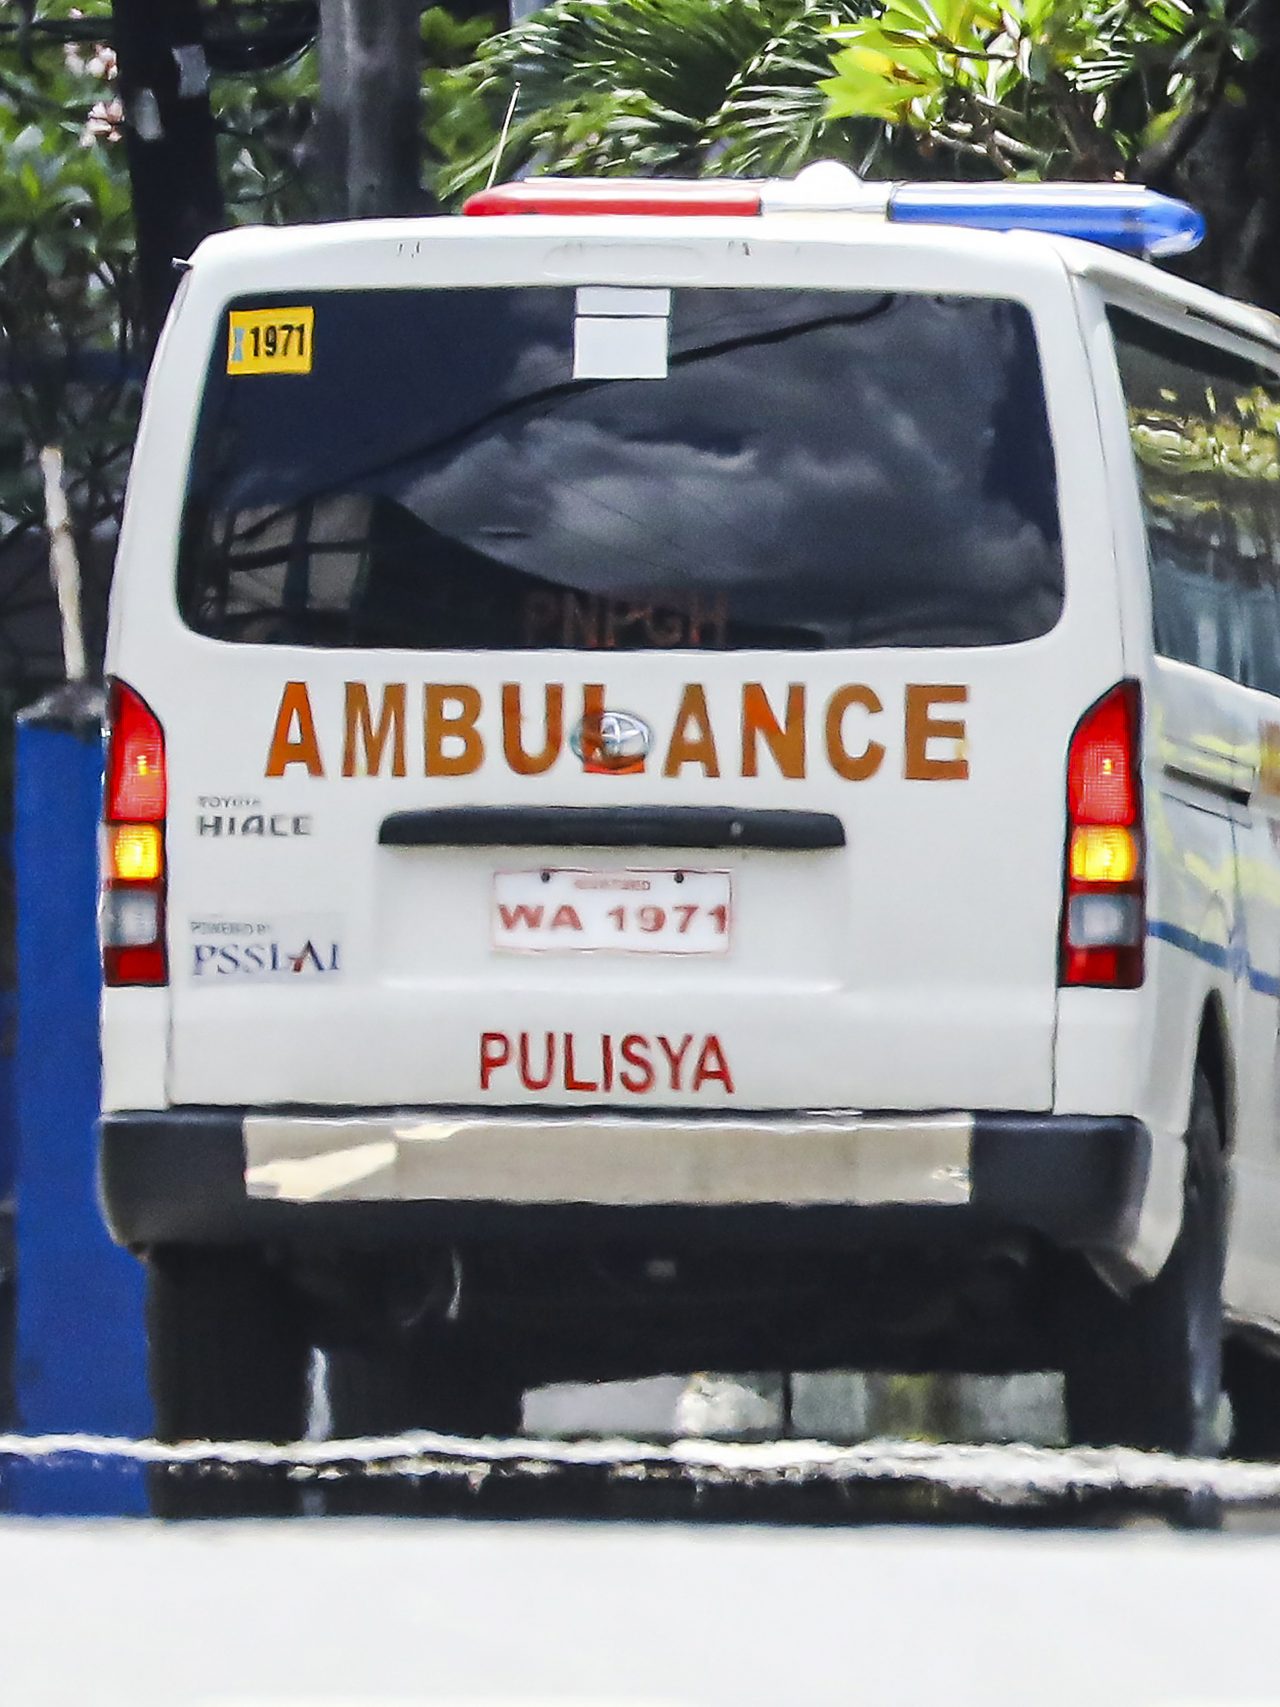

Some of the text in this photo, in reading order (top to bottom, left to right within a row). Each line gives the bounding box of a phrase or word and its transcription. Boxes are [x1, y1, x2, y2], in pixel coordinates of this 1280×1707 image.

[249, 323, 305, 357] 1971
[264, 681, 970, 780] AMBULANCE
[198, 814, 312, 837] HIACE
[498, 904, 728, 935] WA 1971
[480, 1032, 735, 1094] PULISYA
